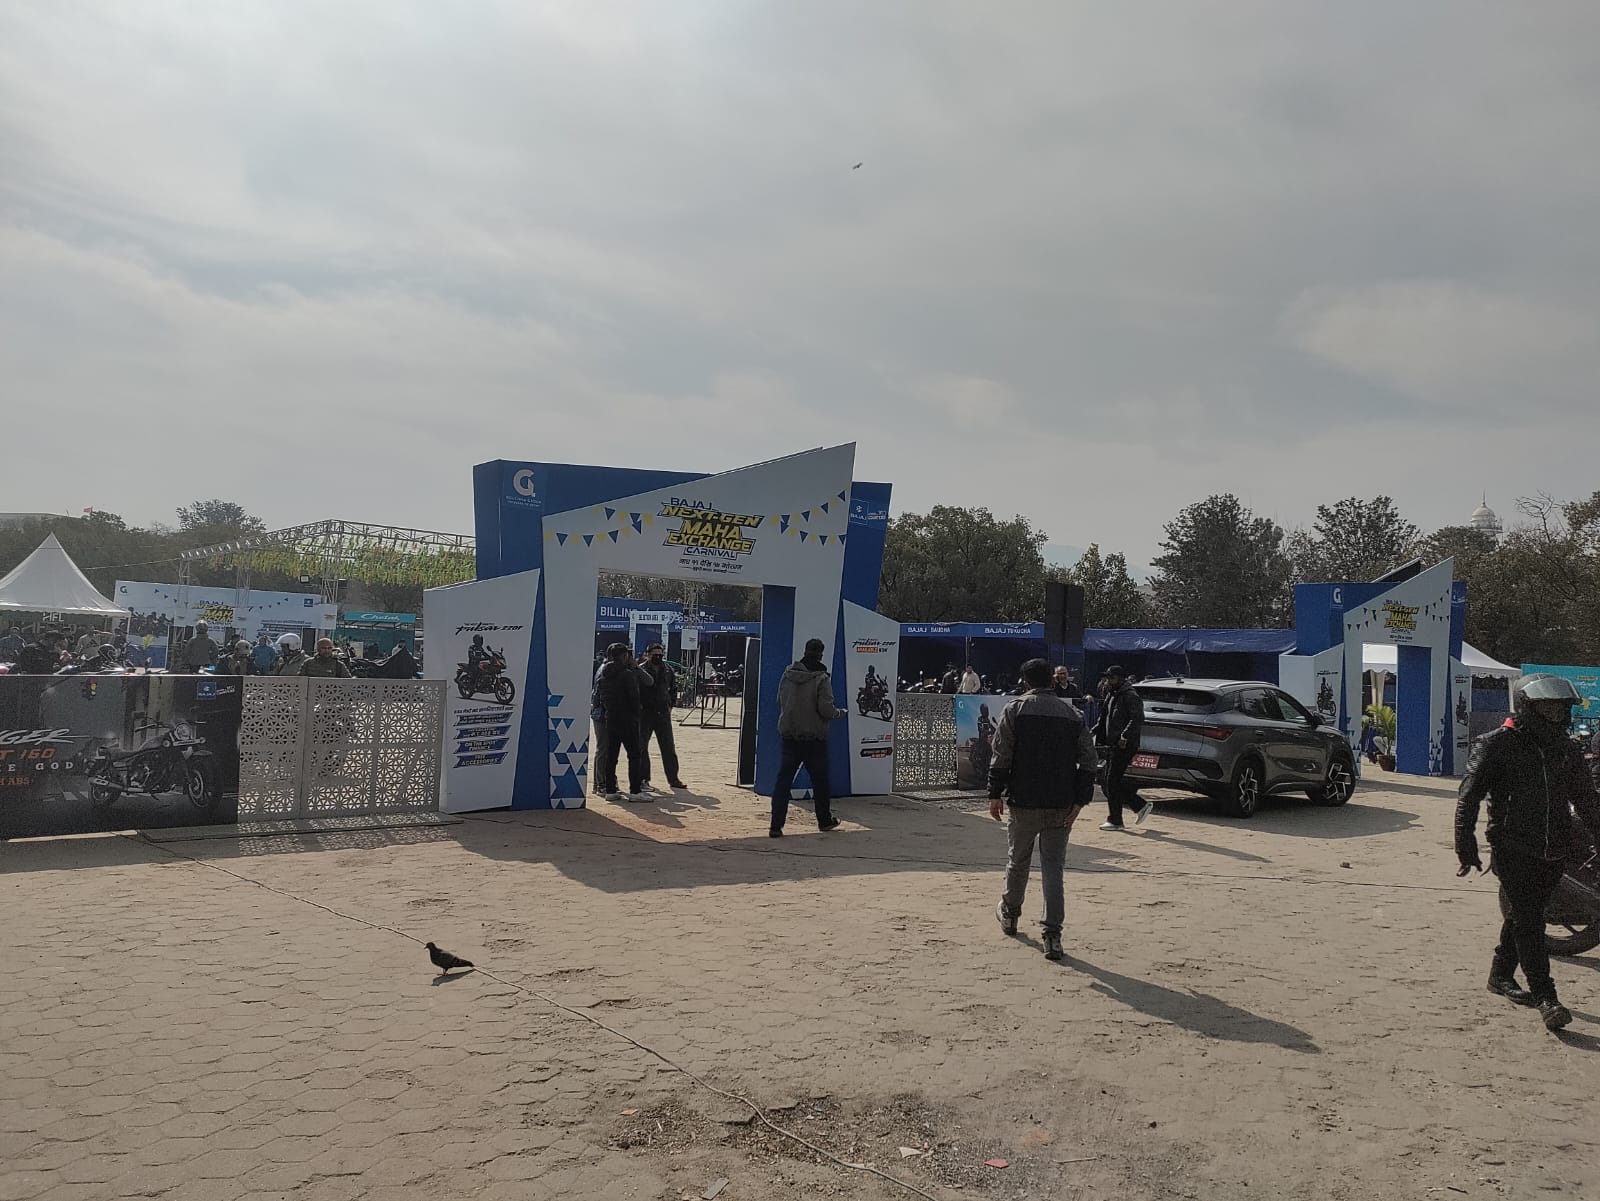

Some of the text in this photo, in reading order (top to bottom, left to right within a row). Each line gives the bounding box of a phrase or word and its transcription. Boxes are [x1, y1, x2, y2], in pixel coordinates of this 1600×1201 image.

[670, 497, 712, 510] BAJAJ
[662, 505, 760, 526] NEXT-GEN
[683, 519, 741, 539] MAHA
[668, 532, 753, 552] EXCHANGE
[686, 547, 735, 558] CARNIVAL
[35, 761, 74, 771] GOD
